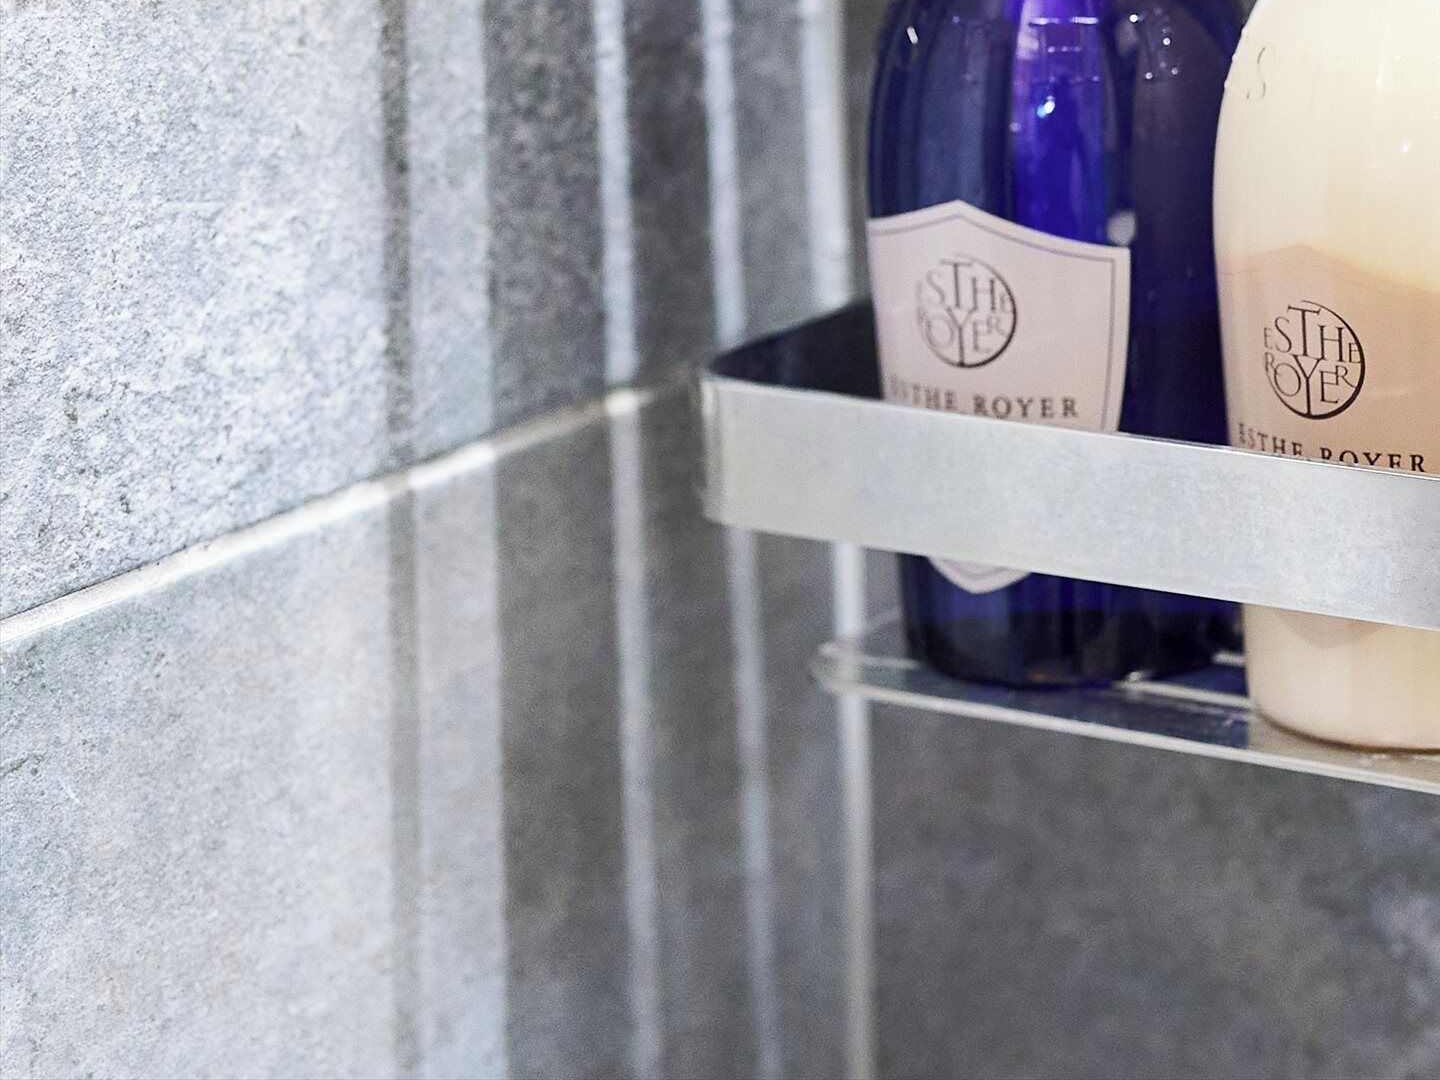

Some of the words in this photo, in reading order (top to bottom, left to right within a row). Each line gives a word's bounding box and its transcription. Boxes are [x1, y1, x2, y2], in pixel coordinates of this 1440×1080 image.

[1263, 304, 1363, 364] ESTHE
[973, 392, 1078, 419] ROYER
[1264, 351, 1357, 418] ROYER
[1319, 446, 1427, 473] ROYER
